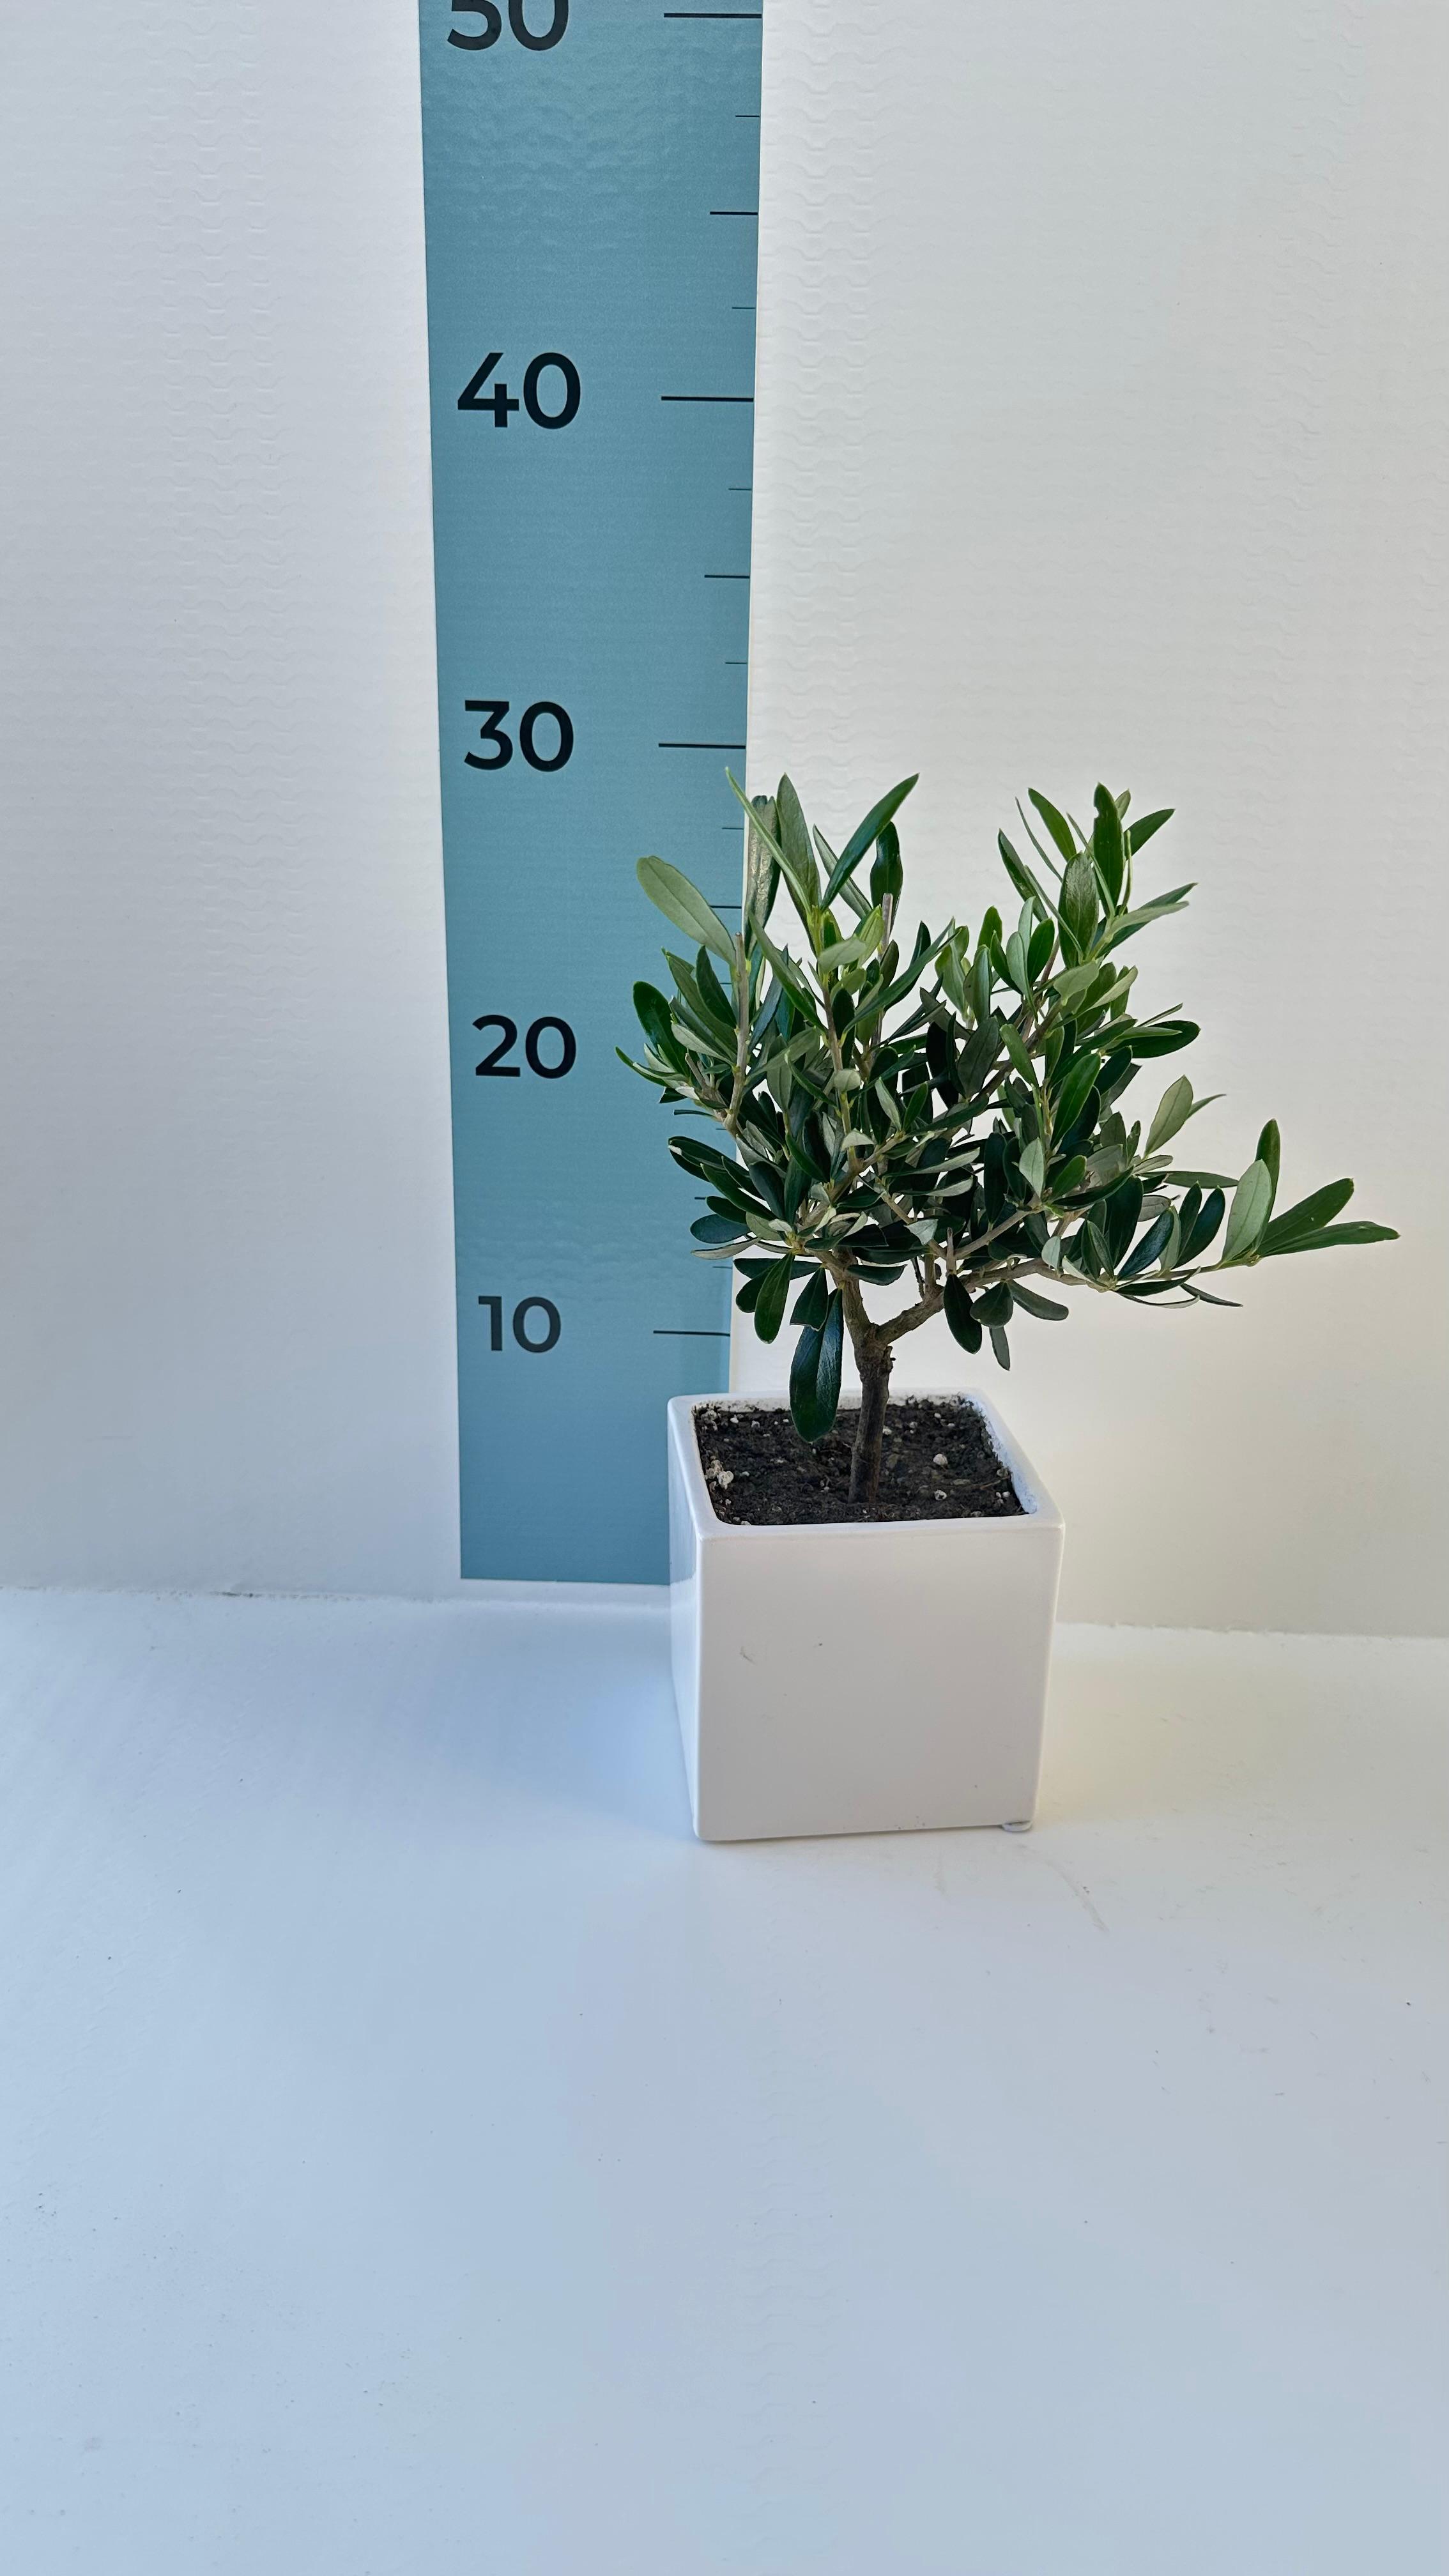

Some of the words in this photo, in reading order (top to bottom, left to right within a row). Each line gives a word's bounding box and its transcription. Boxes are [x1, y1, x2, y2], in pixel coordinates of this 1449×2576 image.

[447, 0, 569, 51] 50
[457, 352, 581, 430] 40
[464, 700, 574, 772] 30
[472, 1015, 576, 1079] 20
[478, 1295, 562, 1353] 10
